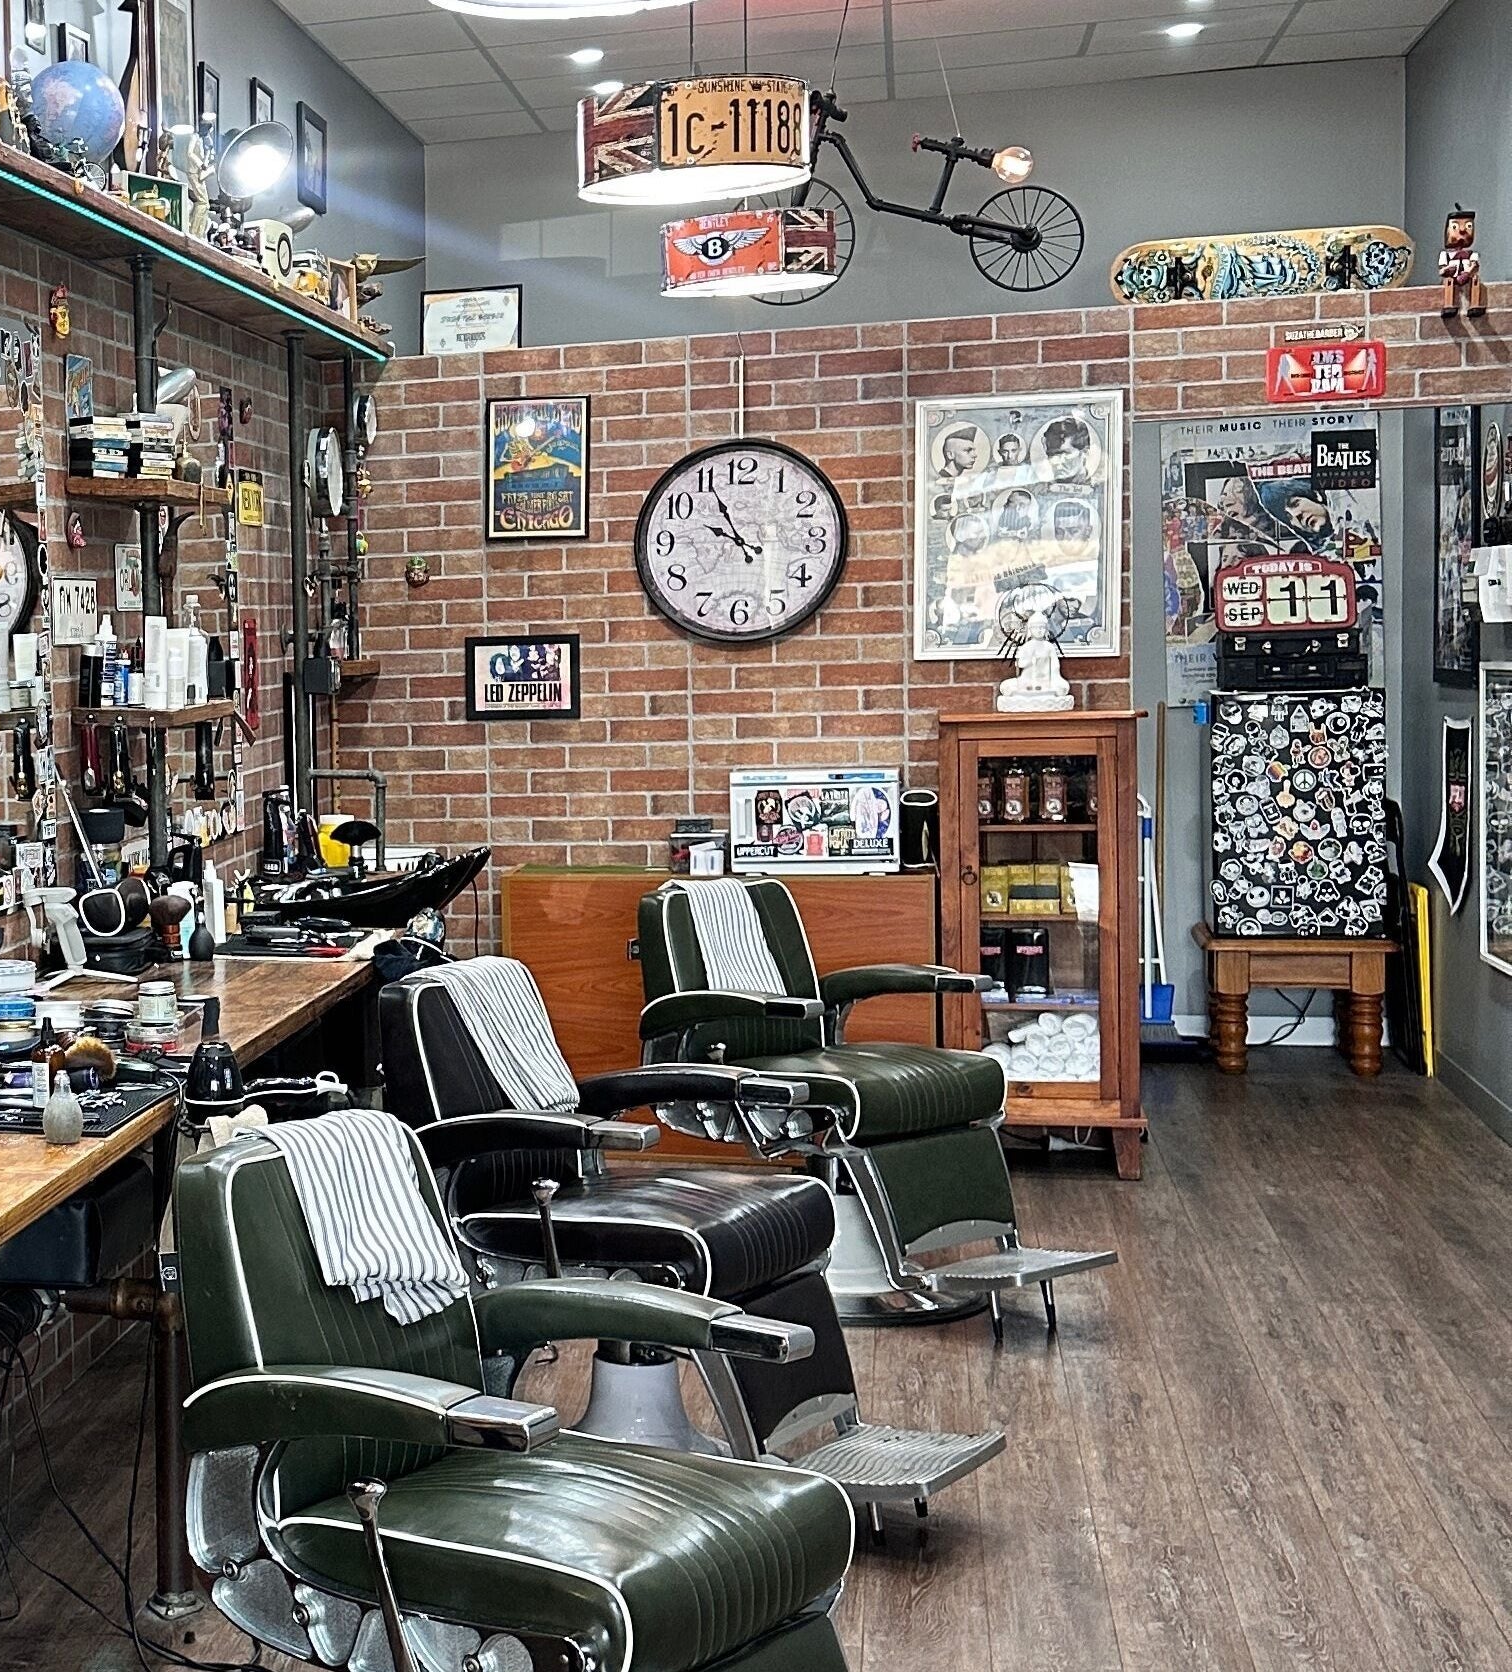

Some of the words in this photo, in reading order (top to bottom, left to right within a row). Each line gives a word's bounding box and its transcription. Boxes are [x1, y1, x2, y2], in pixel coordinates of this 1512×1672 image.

[697, 79, 746, 94] SUNSHINE
[708, 240, 723, 258] B
[1181, 425, 1214, 435] THEIR
[1219, 421, 1262, 433] MUSIC
[1272, 419, 1306, 429] THEIR
[1311, 414, 1355, 426] STORY
[1338, 442, 1349, 450] THE
[1316, 444, 1372, 469] BEATLES
[727, 457, 758, 485] 12
[1251, 465, 1273, 475] THE
[696, 466, 714, 493] 11
[777, 466, 785, 493] 1
[1319, 478, 1371, 488] VIDEO
[666, 492, 694, 520] 10
[795, 490, 817, 518] 2
[656, 530, 675, 557] 9
[805, 526, 827, 554] 3
[1252, 563, 1294, 574] TODAY
[1298, 561, 1312, 572] IS
[666, 564, 688, 591] 8
[788, 563, 813, 588] 4
[1227, 582, 1258, 594] WED
[695, 592, 713, 617] 7
[729, 599, 749, 625] 6
[766, 589, 786, 615] 5
[1228, 608, 1260, 620] SEP
[485, 683, 504, 703] LED
[508, 682, 562, 703] ZEPPELIN
[736, 845, 776, 857] UPPERCUT
[853, 838, 889, 849] DELUXE
